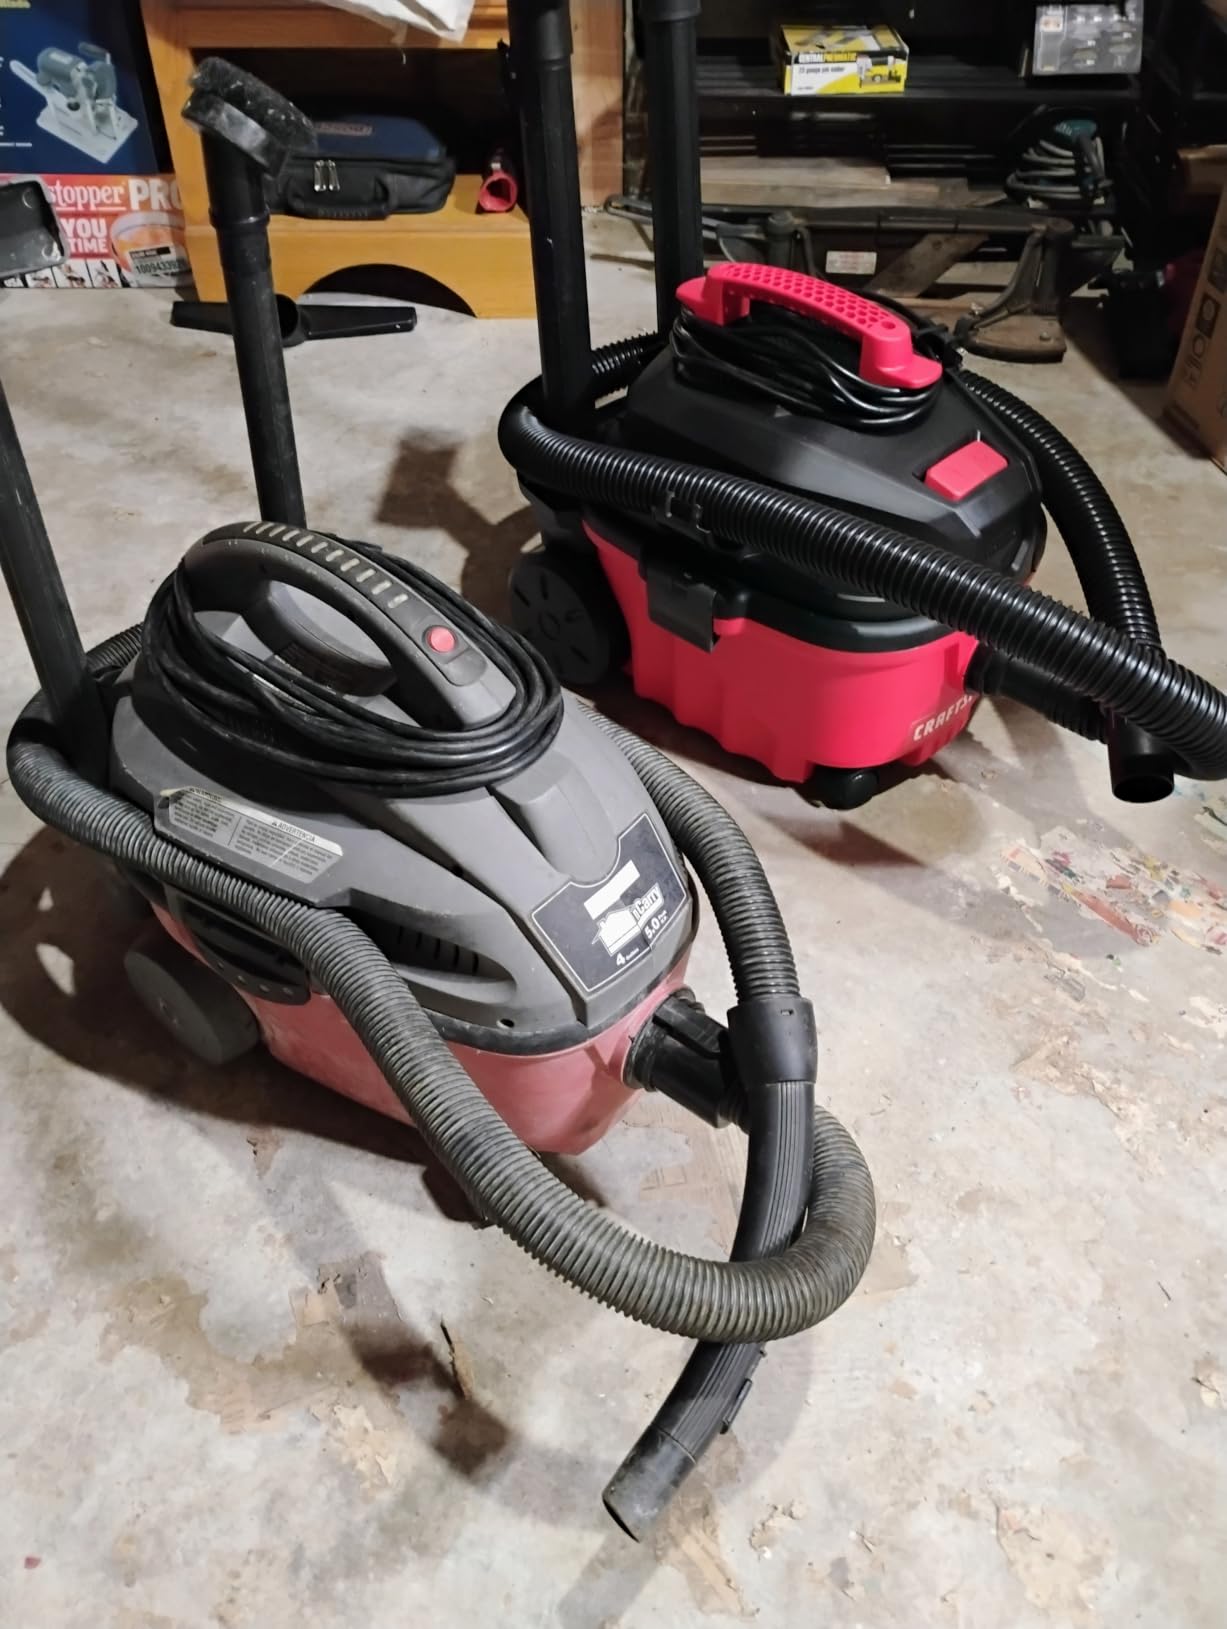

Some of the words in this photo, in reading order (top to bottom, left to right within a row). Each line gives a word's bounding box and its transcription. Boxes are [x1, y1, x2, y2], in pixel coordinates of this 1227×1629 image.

[60, 217, 107, 238] YOU
[69, 238, 107, 253] TIME
[645, 919, 660, 939] 5.0
[616, 952, 626, 966] 4
